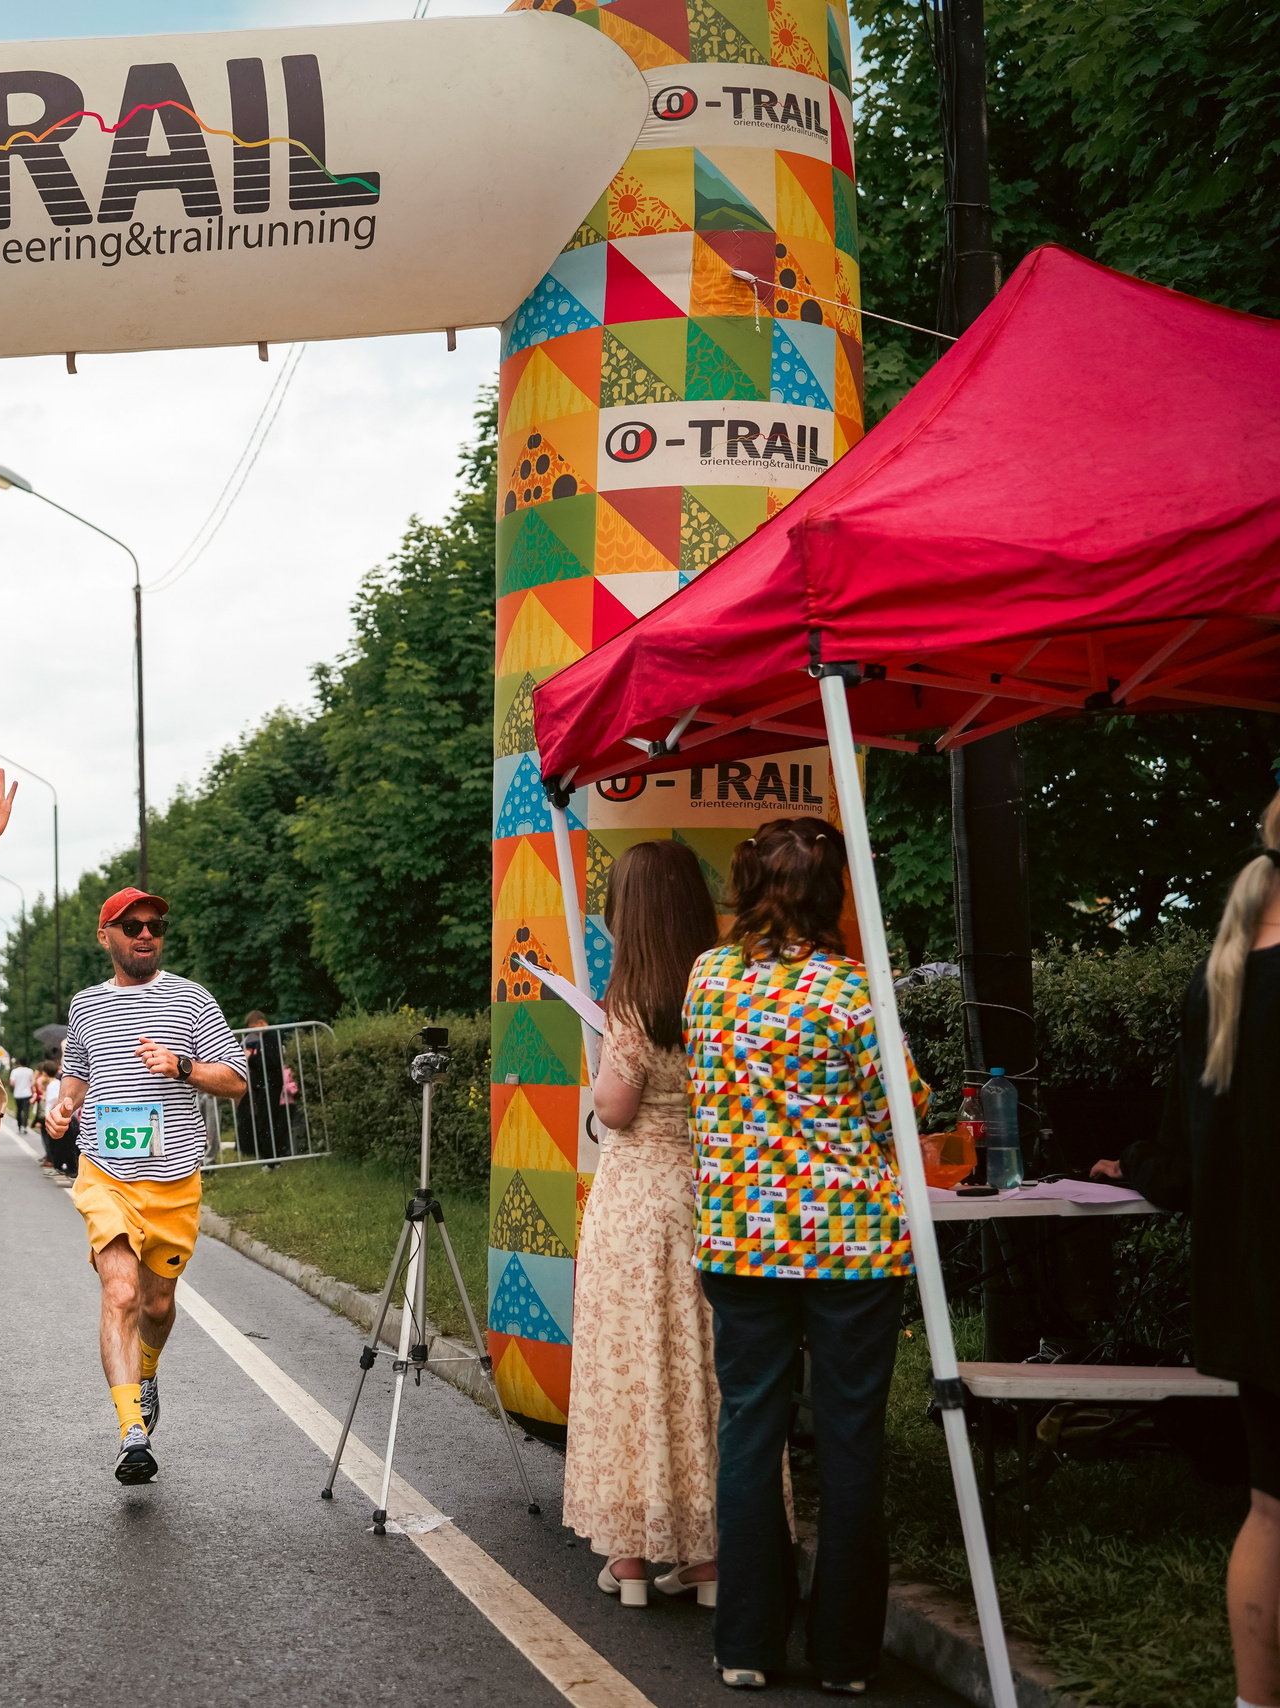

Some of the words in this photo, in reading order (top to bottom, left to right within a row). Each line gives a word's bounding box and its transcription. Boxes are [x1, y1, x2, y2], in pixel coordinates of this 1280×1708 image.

[734, 119, 829, 144] orienteering&trailrunning
[690, 799, 823, 815] orienteering&trailrunning
[105, 1127, 153, 1149] 857
